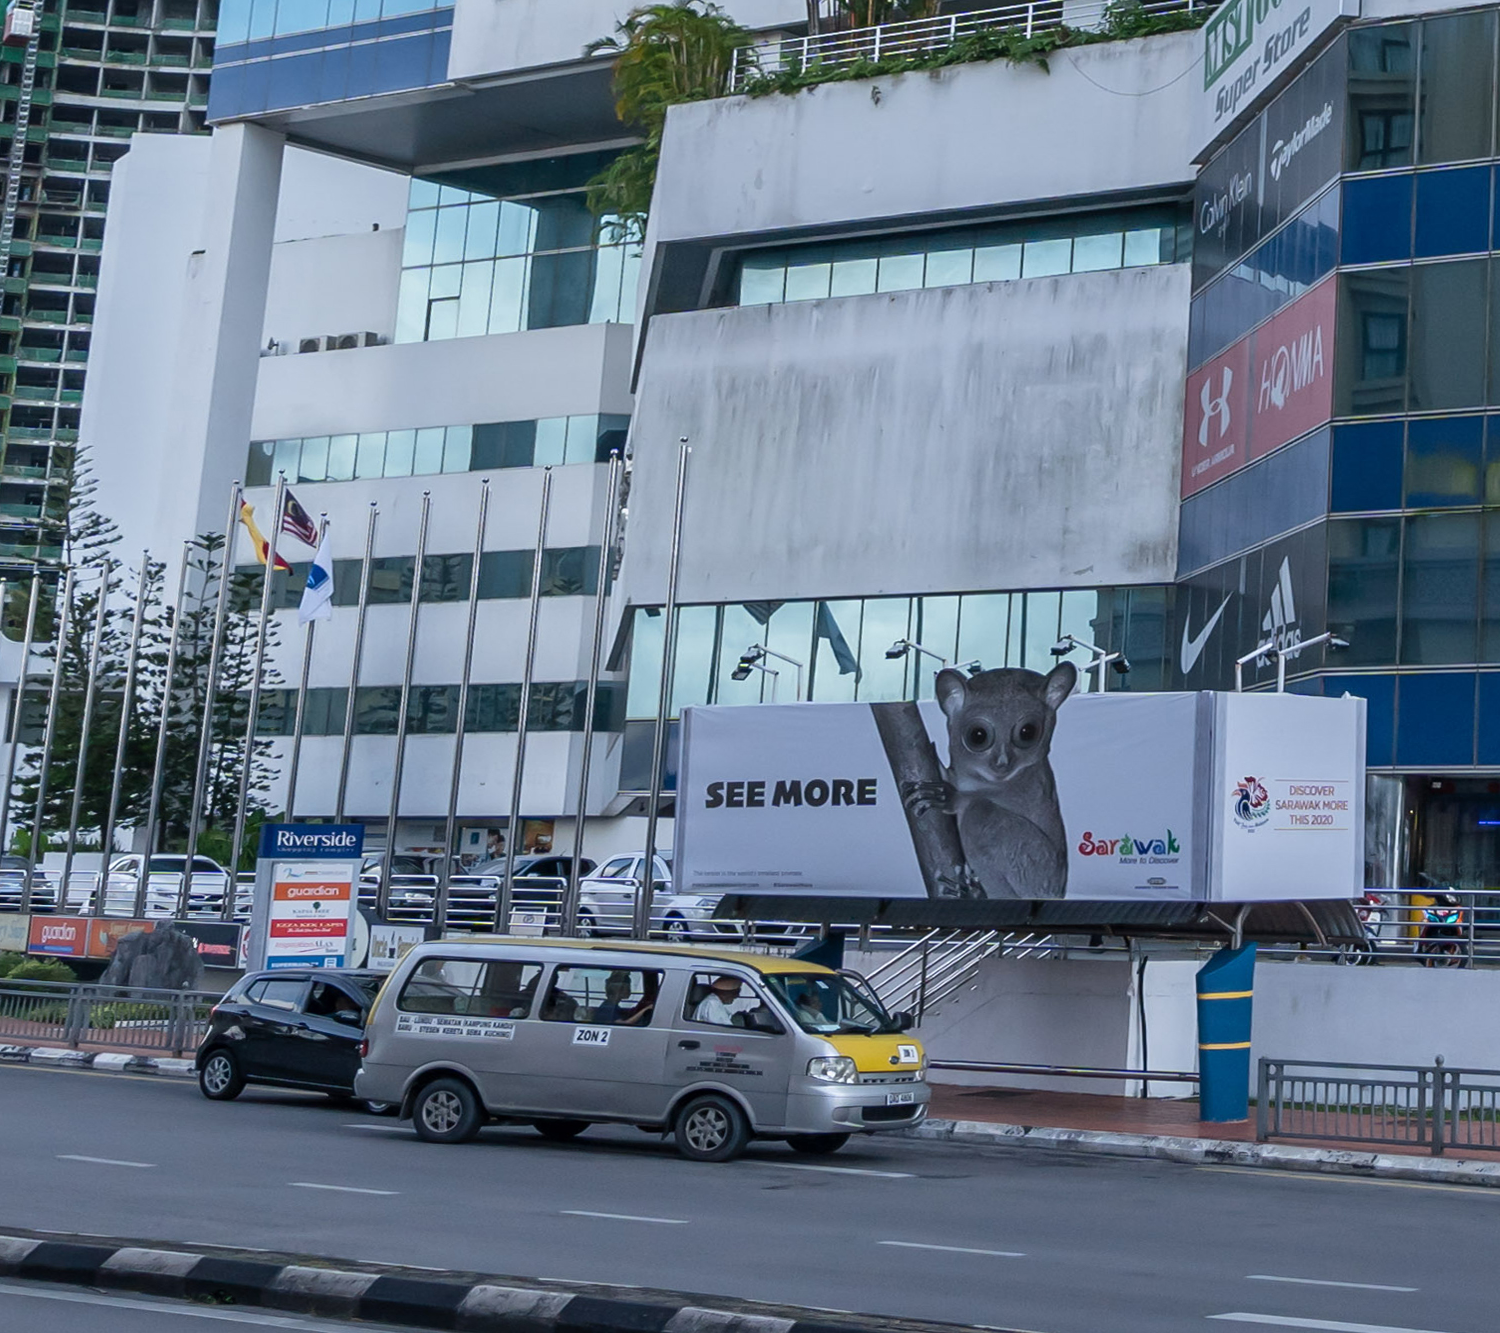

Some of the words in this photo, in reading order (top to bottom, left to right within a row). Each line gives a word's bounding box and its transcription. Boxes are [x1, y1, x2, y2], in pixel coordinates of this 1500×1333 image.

[1215, 54, 1261, 123] Super
[1262, 6, 1311, 75] Store
[1270, 102, 1333, 181] TaylorMade
[1201, 186, 1228, 234] Calvin
[1229, 167, 1252, 211] Klein
[1258, 324, 1324, 414] HONMA
[1256, 624, 1301, 668] adidas
[705, 780, 766, 809] SEE
[771, 778, 878, 808] MORE
[1289, 785, 1335, 796] DISCOVER
[1275, 799, 1321, 811] SARAWAK
[1322, 800, 1349, 811] MORE
[1289, 814, 1309, 825] THIS
[1310, 814, 1334, 826] 2020
[277, 830, 356, 847] Riverside
[1078, 828, 1180, 856] Sarawak
[1119, 856, 1138, 864] More
[1148, 856, 1179, 864] Discover
[287, 885, 339, 898] guardian
[41, 922, 76, 944] guardian
[576, 1029, 598, 1042] ZON
[600, 1031, 609, 1043] 2
